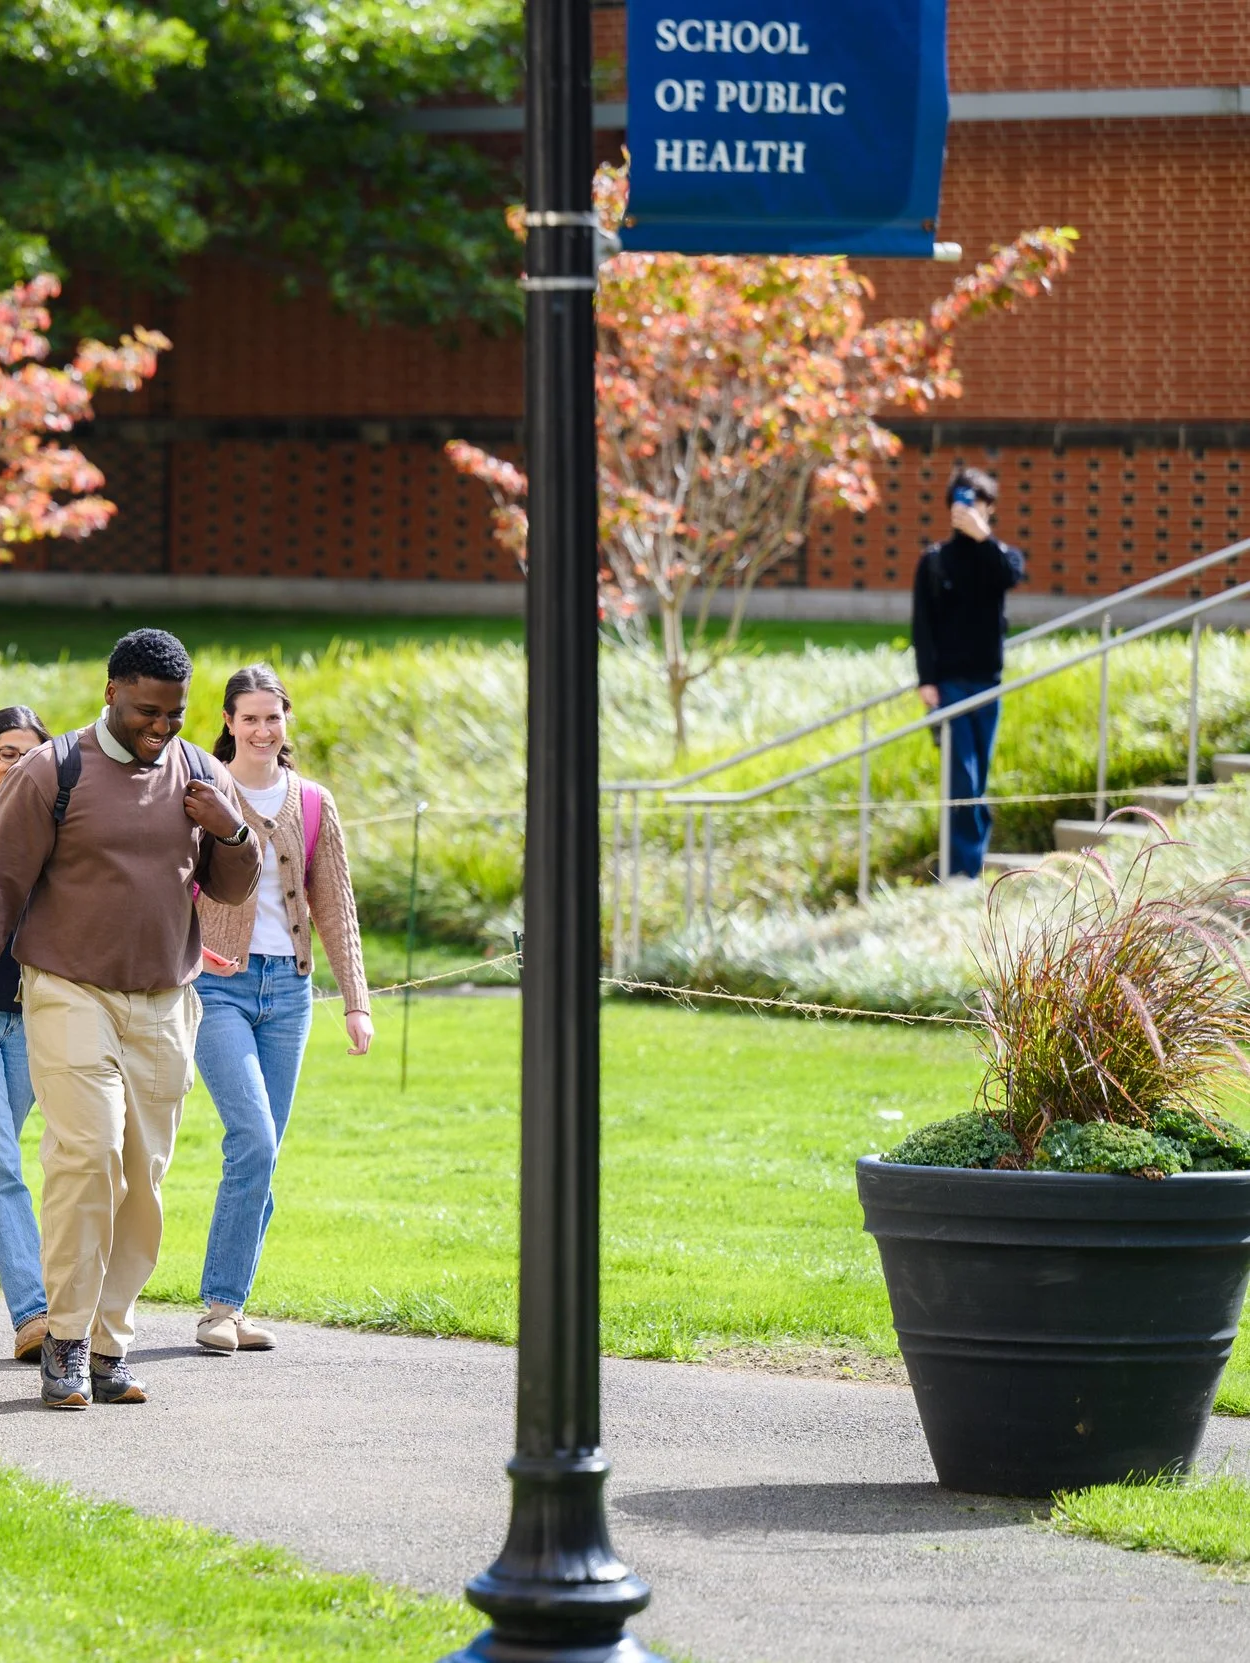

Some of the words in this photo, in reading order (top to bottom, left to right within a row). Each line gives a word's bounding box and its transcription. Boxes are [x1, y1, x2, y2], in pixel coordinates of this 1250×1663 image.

[655, 18, 810, 54] SCHOOL
[654, 78, 706, 113] OF
[715, 79, 847, 115] PUBLIC
[654, 138, 806, 174] HEALTH
